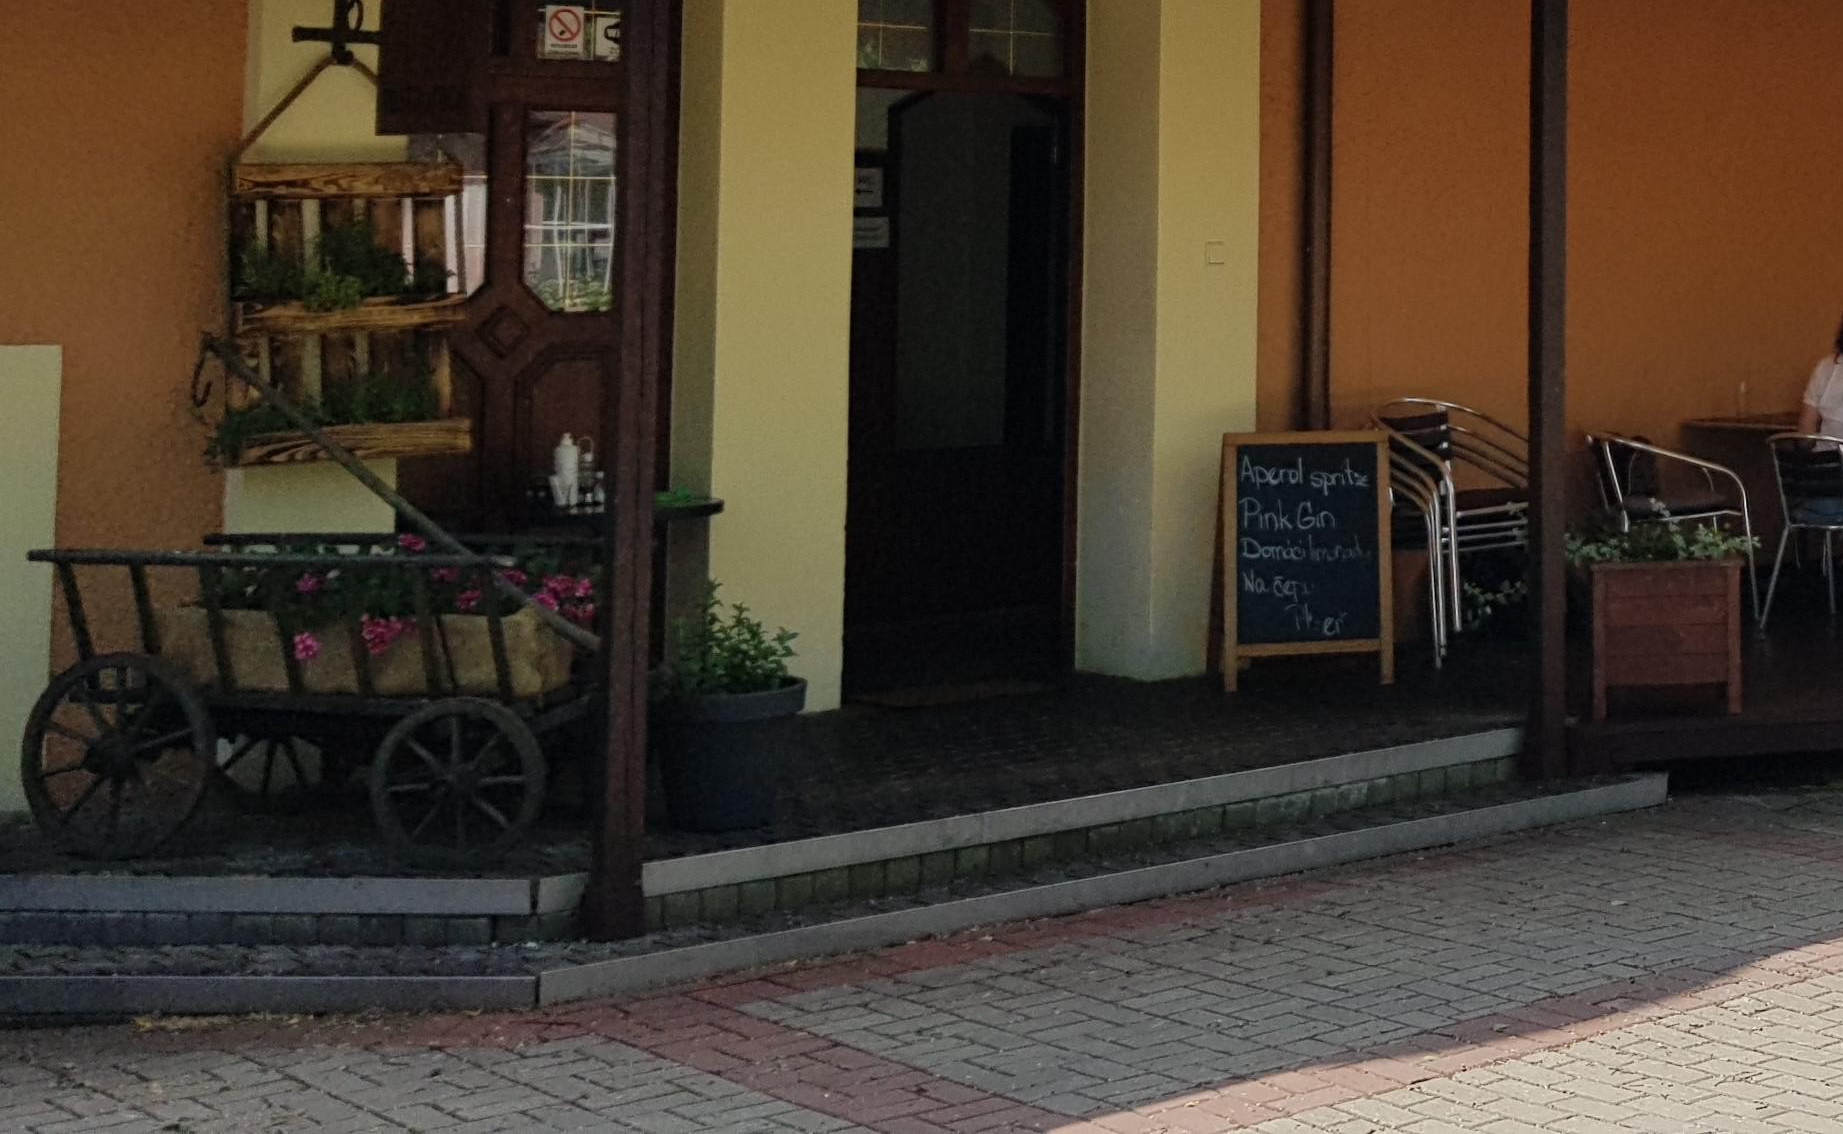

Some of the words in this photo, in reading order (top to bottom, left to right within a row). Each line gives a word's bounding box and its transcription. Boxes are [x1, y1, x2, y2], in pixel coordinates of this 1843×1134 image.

[1240, 454, 1304, 490] Aperol
[1309, 457, 1370, 496] spritz
[1238, 496, 1294, 531] Pink
[1296, 499, 1336, 530] Gin
[1241, 568, 1270, 594] Na
